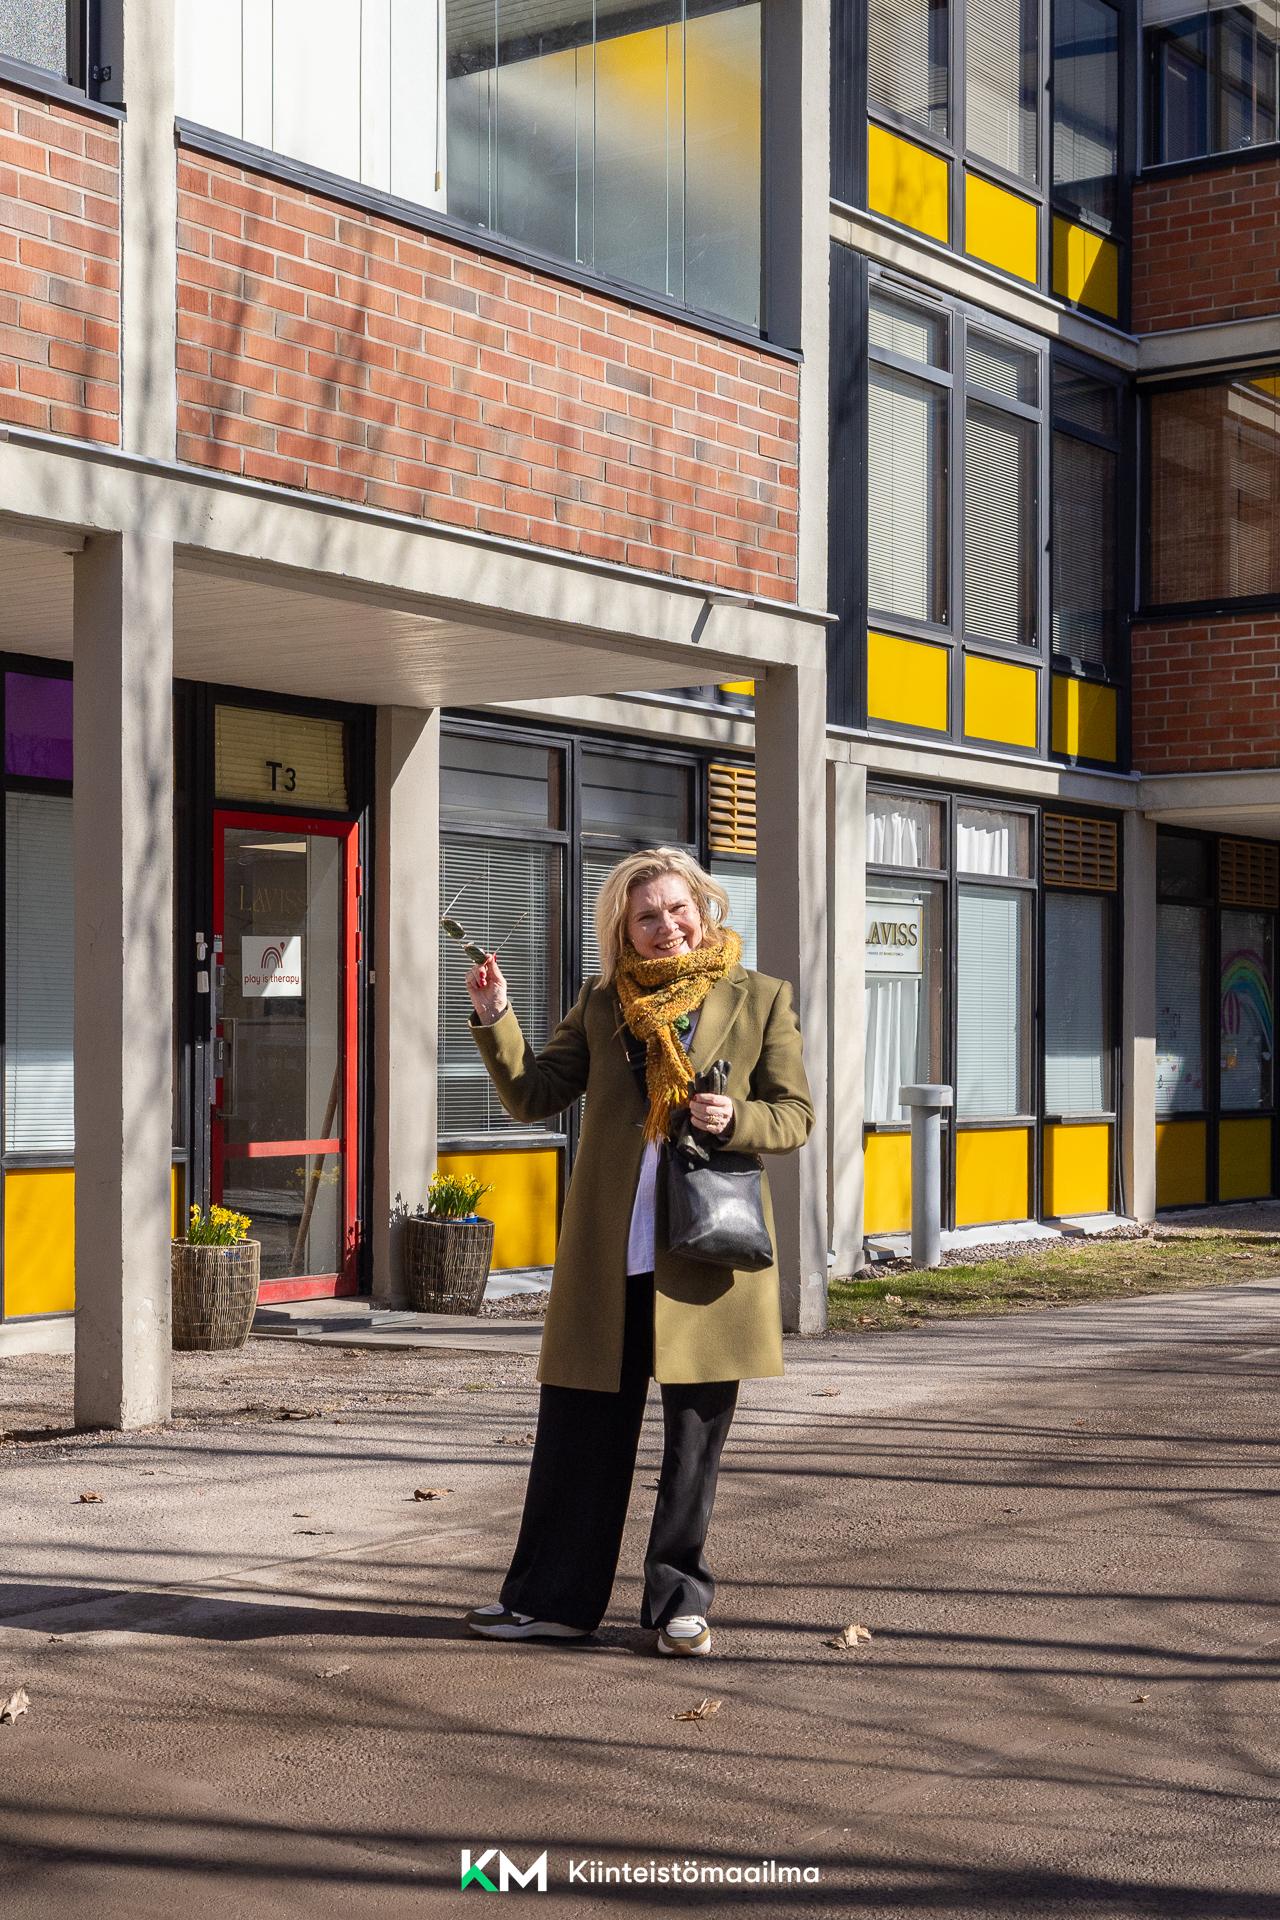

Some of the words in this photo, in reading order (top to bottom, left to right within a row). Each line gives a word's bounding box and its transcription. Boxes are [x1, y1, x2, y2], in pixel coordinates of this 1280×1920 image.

[266, 761, 296, 792] T3
[865, 921, 918, 947] AVISS
[244, 974, 260, 985] play
[262, 974, 269, 984] is
[270, 974, 299, 985] therapy
